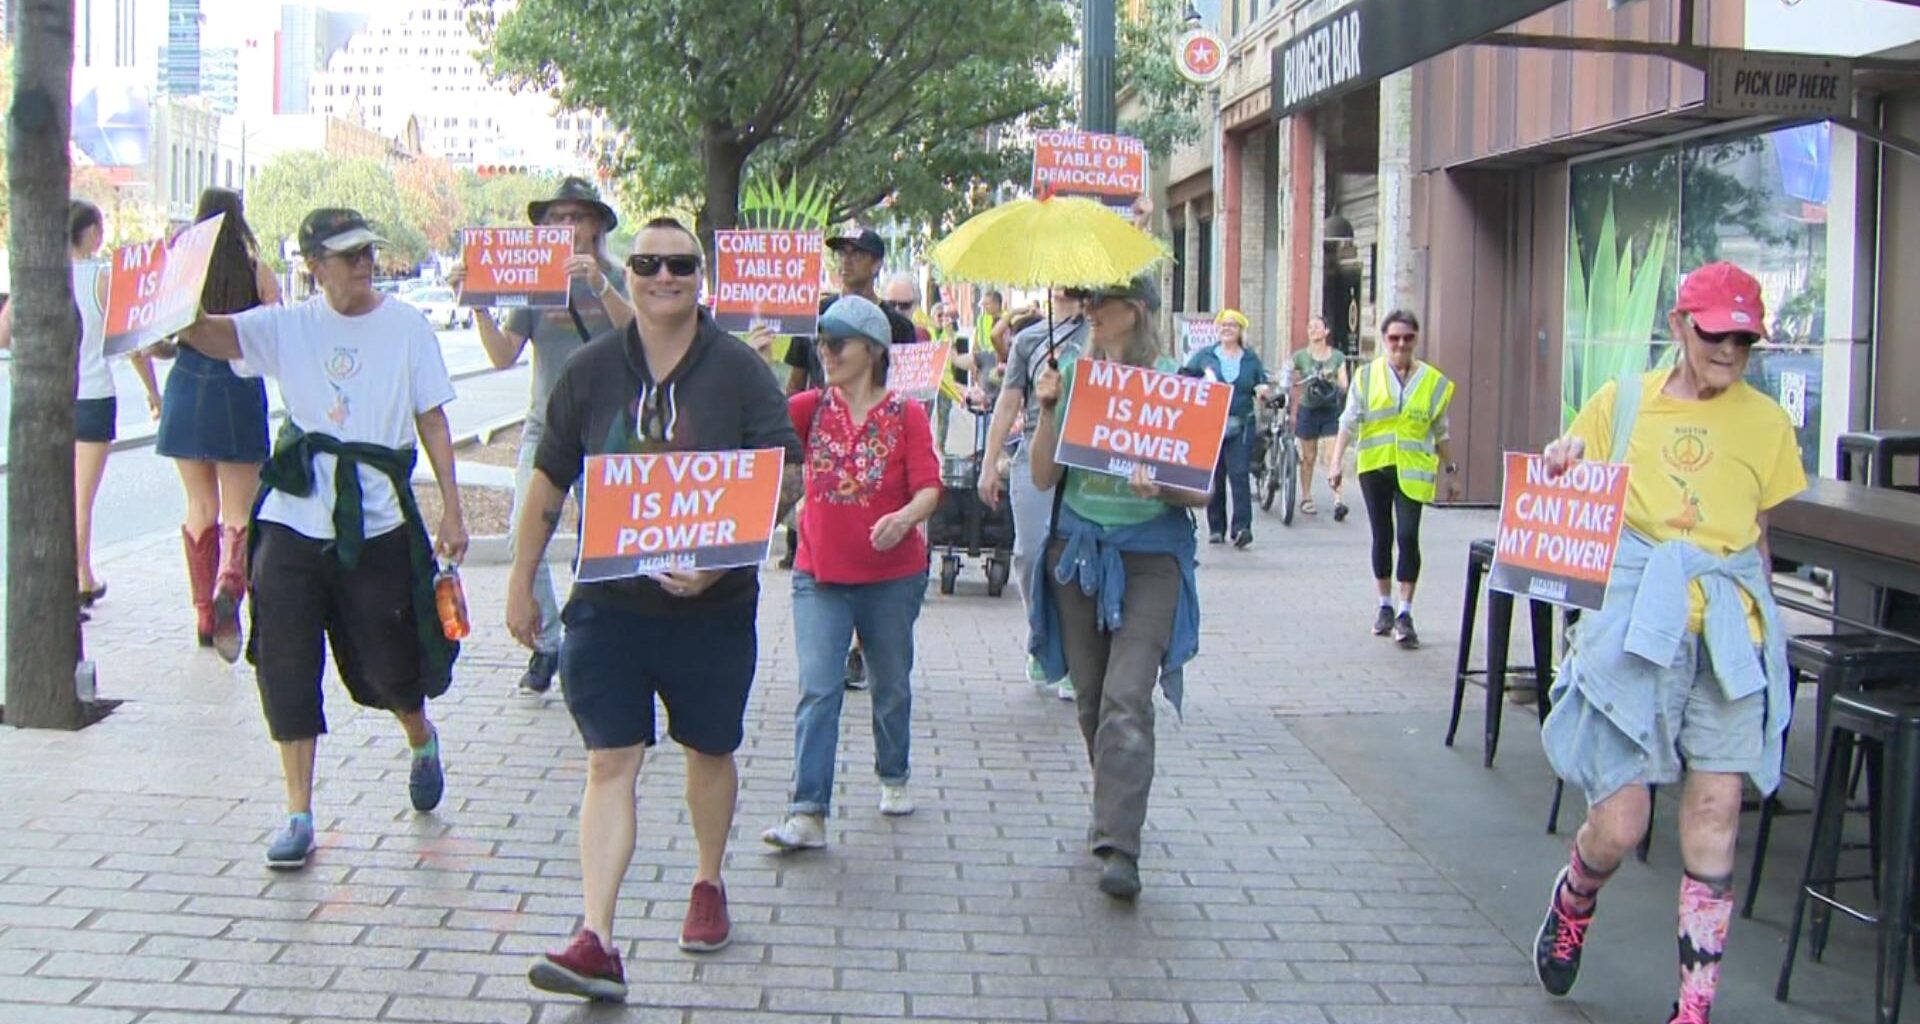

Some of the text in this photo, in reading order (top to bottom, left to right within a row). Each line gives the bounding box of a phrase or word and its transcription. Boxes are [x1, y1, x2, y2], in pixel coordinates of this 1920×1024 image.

[1283, 10, 1361, 108] BURGER BAR
[1734, 70, 1838, 99] PICK UP HERE
[1038, 133, 1142, 154] COME TO THE
[1053, 150, 1128, 170] TABLE OF
[1037, 167, 1139, 189] DEMOCRACY
[464, 229, 570, 246] IT'S TIME FOR
[719, 234, 821, 253] COME TO THE
[123, 241, 156, 271] MY
[480, 249, 552, 265] A VISION
[735, 259, 806, 279] TABLE OF
[138, 272, 157, 299] IS
[491, 267, 538, 284] VOTE!
[720, 283, 816, 304] DEMOCRACY
[1088, 360, 1211, 406] MY VOTE
[1107, 397, 1182, 431] IS MY
[1092, 424, 1190, 465] POWER
[604, 452, 755, 486] MY VOTE
[631, 487, 725, 520] IS MY
[1515, 492, 1615, 533] CAN TAKE
[616, 519, 737, 554] POWER
[1500, 527, 1610, 572] MY POWER!
